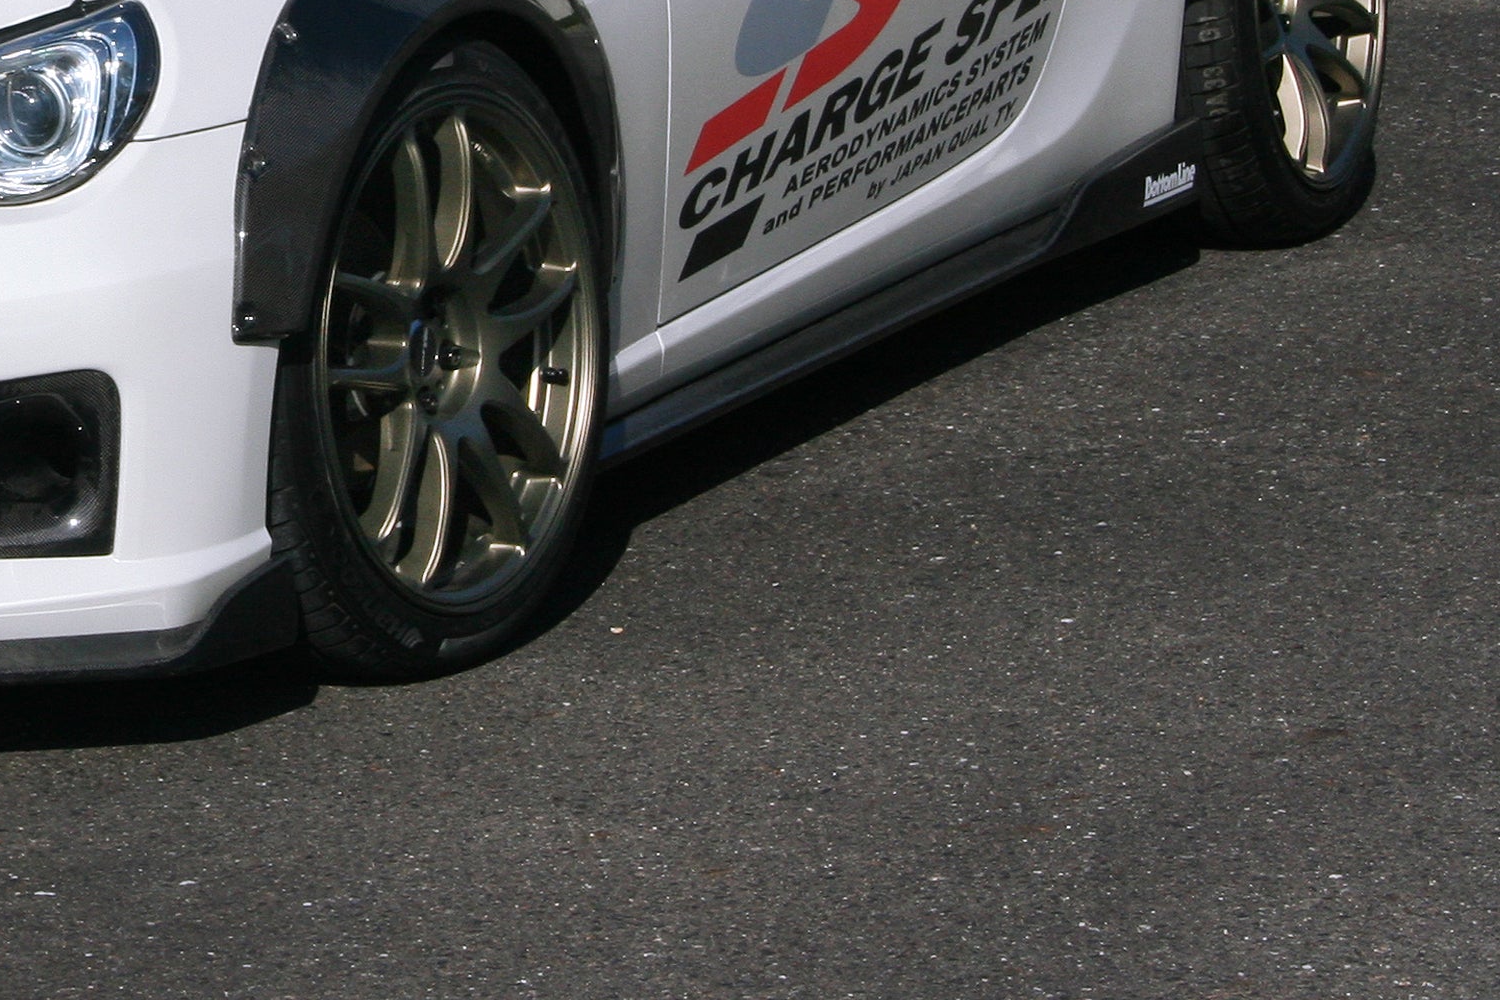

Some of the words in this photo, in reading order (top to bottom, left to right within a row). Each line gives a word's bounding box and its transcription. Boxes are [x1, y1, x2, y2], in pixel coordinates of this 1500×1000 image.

[678, 17, 946, 230] CHARGE
[782, 71, 963, 199] AERODYNAMICS
[964, 10, 1051, 87] SYSTEM
[762, 195, 803, 236] and
[866, 178, 888, 200] by
[890, 139, 947, 187] JAPAN
